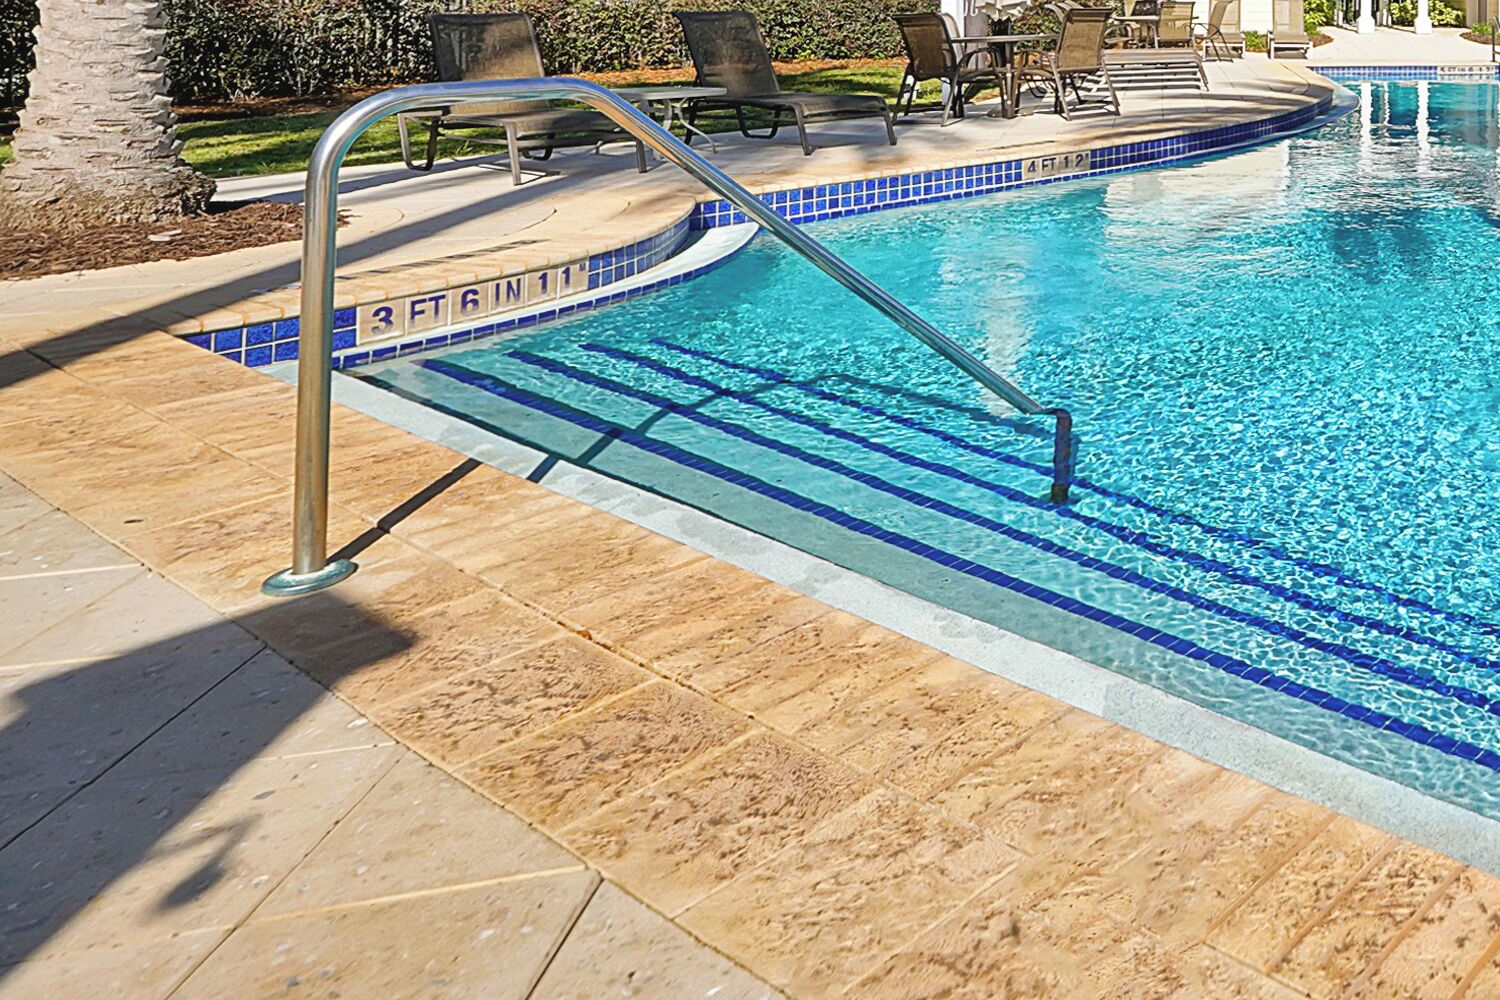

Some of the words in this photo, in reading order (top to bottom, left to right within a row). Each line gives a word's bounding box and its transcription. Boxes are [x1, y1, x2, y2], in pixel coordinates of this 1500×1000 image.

[1028, 161, 1036, 172] 4
[1041, 157, 1056, 171] FT
[371, 306, 394, 335] 3
[410, 294, 446, 325] FT
[460, 288, 480, 315] 6
[494, 278, 521, 308] IN
